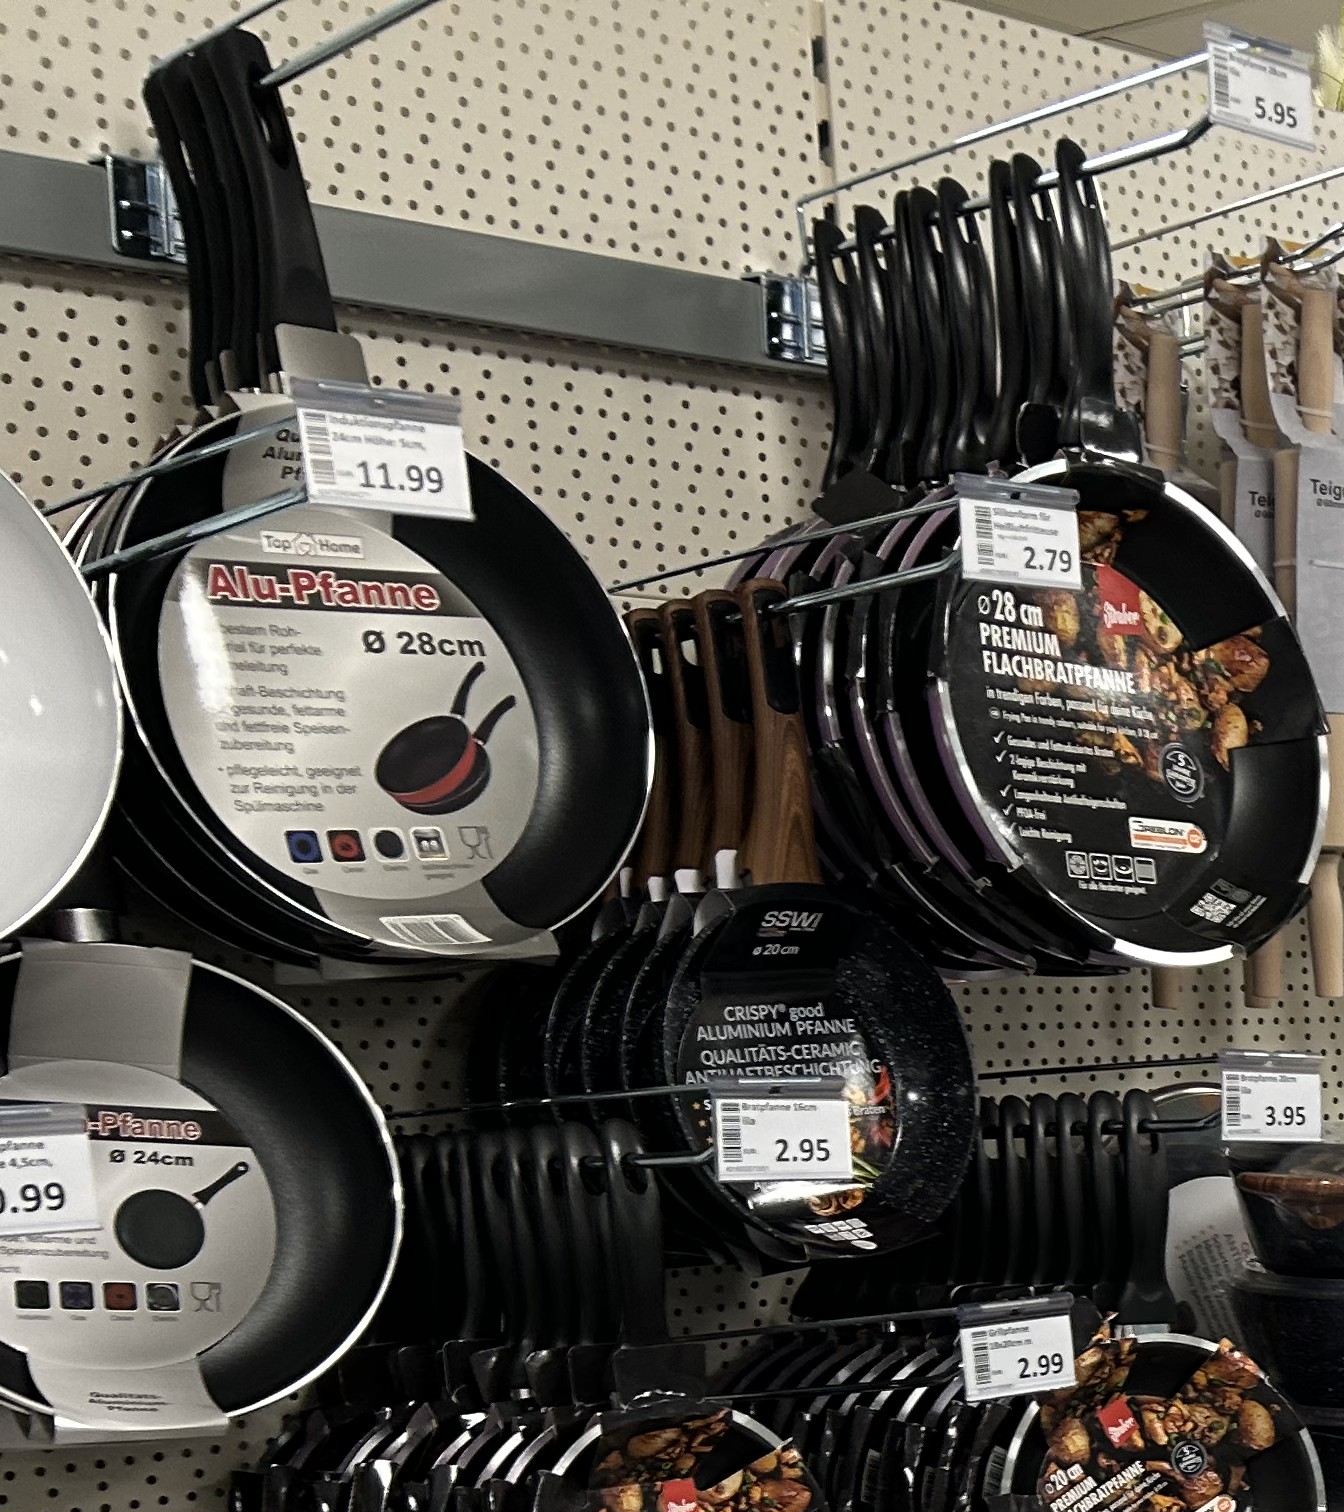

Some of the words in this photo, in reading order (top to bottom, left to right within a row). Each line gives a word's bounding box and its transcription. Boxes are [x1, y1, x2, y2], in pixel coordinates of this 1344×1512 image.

[1255, 96, 1298, 128] 5.95
[356, 460, 443, 493] 11.99
[265, 535, 290, 551] Top
[319, 538, 360, 555] Home
[1023, 546, 1073, 573] 2.79
[208, 564, 441, 612] Alu-Pfanne
[992, 589, 1016, 622] 28
[1020, 603, 1044, 628] cm
[362, 629, 386, 653] Ø
[396, 631, 487, 657] 28cm
[979, 622, 1062, 658] PREMIUM
[982, 650, 1137, 695] FLACHBRATPFANNE
[789, 1001, 825, 1020] good
[696, 1022, 792, 1042] ALUMINIUM
[796, 1018, 856, 1036] PFANNE
[700, 1042, 863, 1067] QUALITÄTS-CERAMIC
[84, 1111, 201, 1140] -Pfanne
[1265, 1105, 1306, 1125] 3.95
[134, 1149, 194, 1167] 24cm
[775, 1138, 831, 1163] 2.95
[1018, 1352, 1064, 1380] 2.99
[1049, 1470, 1069, 1492] 20
[1066, 1463, 1084, 1483] cm
